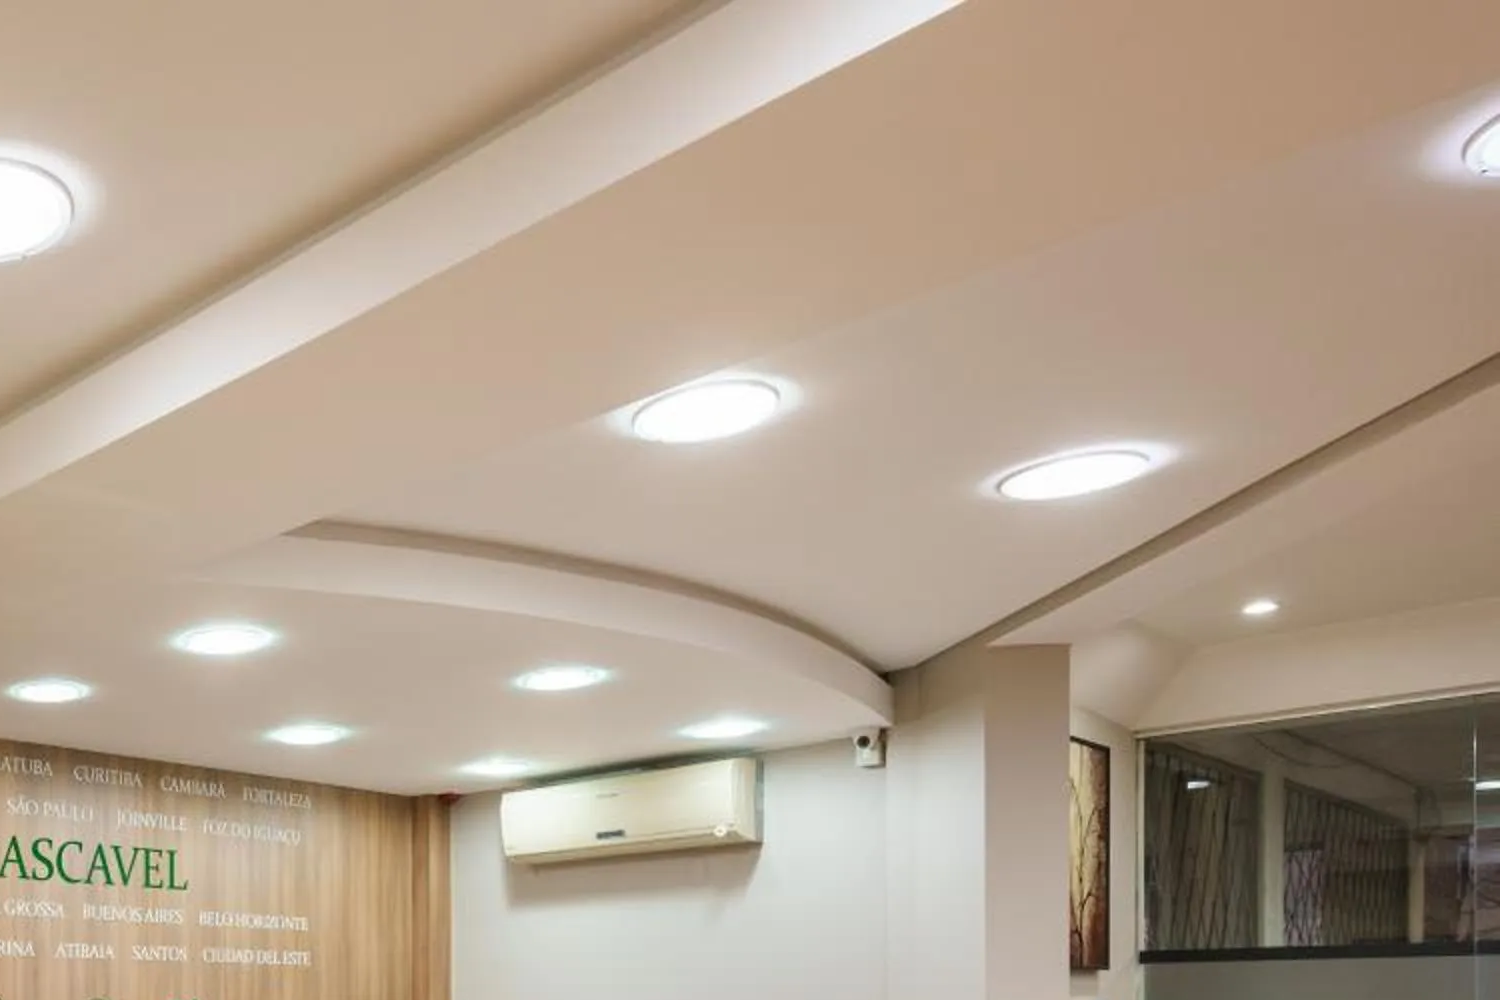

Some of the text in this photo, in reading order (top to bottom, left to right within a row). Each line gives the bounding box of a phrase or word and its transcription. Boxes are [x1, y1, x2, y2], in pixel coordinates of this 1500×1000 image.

[73, 765, 143, 789] CURITIBA
[243, 786, 312, 809] FORTALEZA
[43, 801, 94, 822] PAULO
[116, 808, 187, 832] JOINVILLE
[3, 900, 65, 920] GROSSA
[83, 903, 142, 923] BUENOS
[55, 941, 115, 960] ATIBAIA
[131, 944, 188, 962] SANTOS
